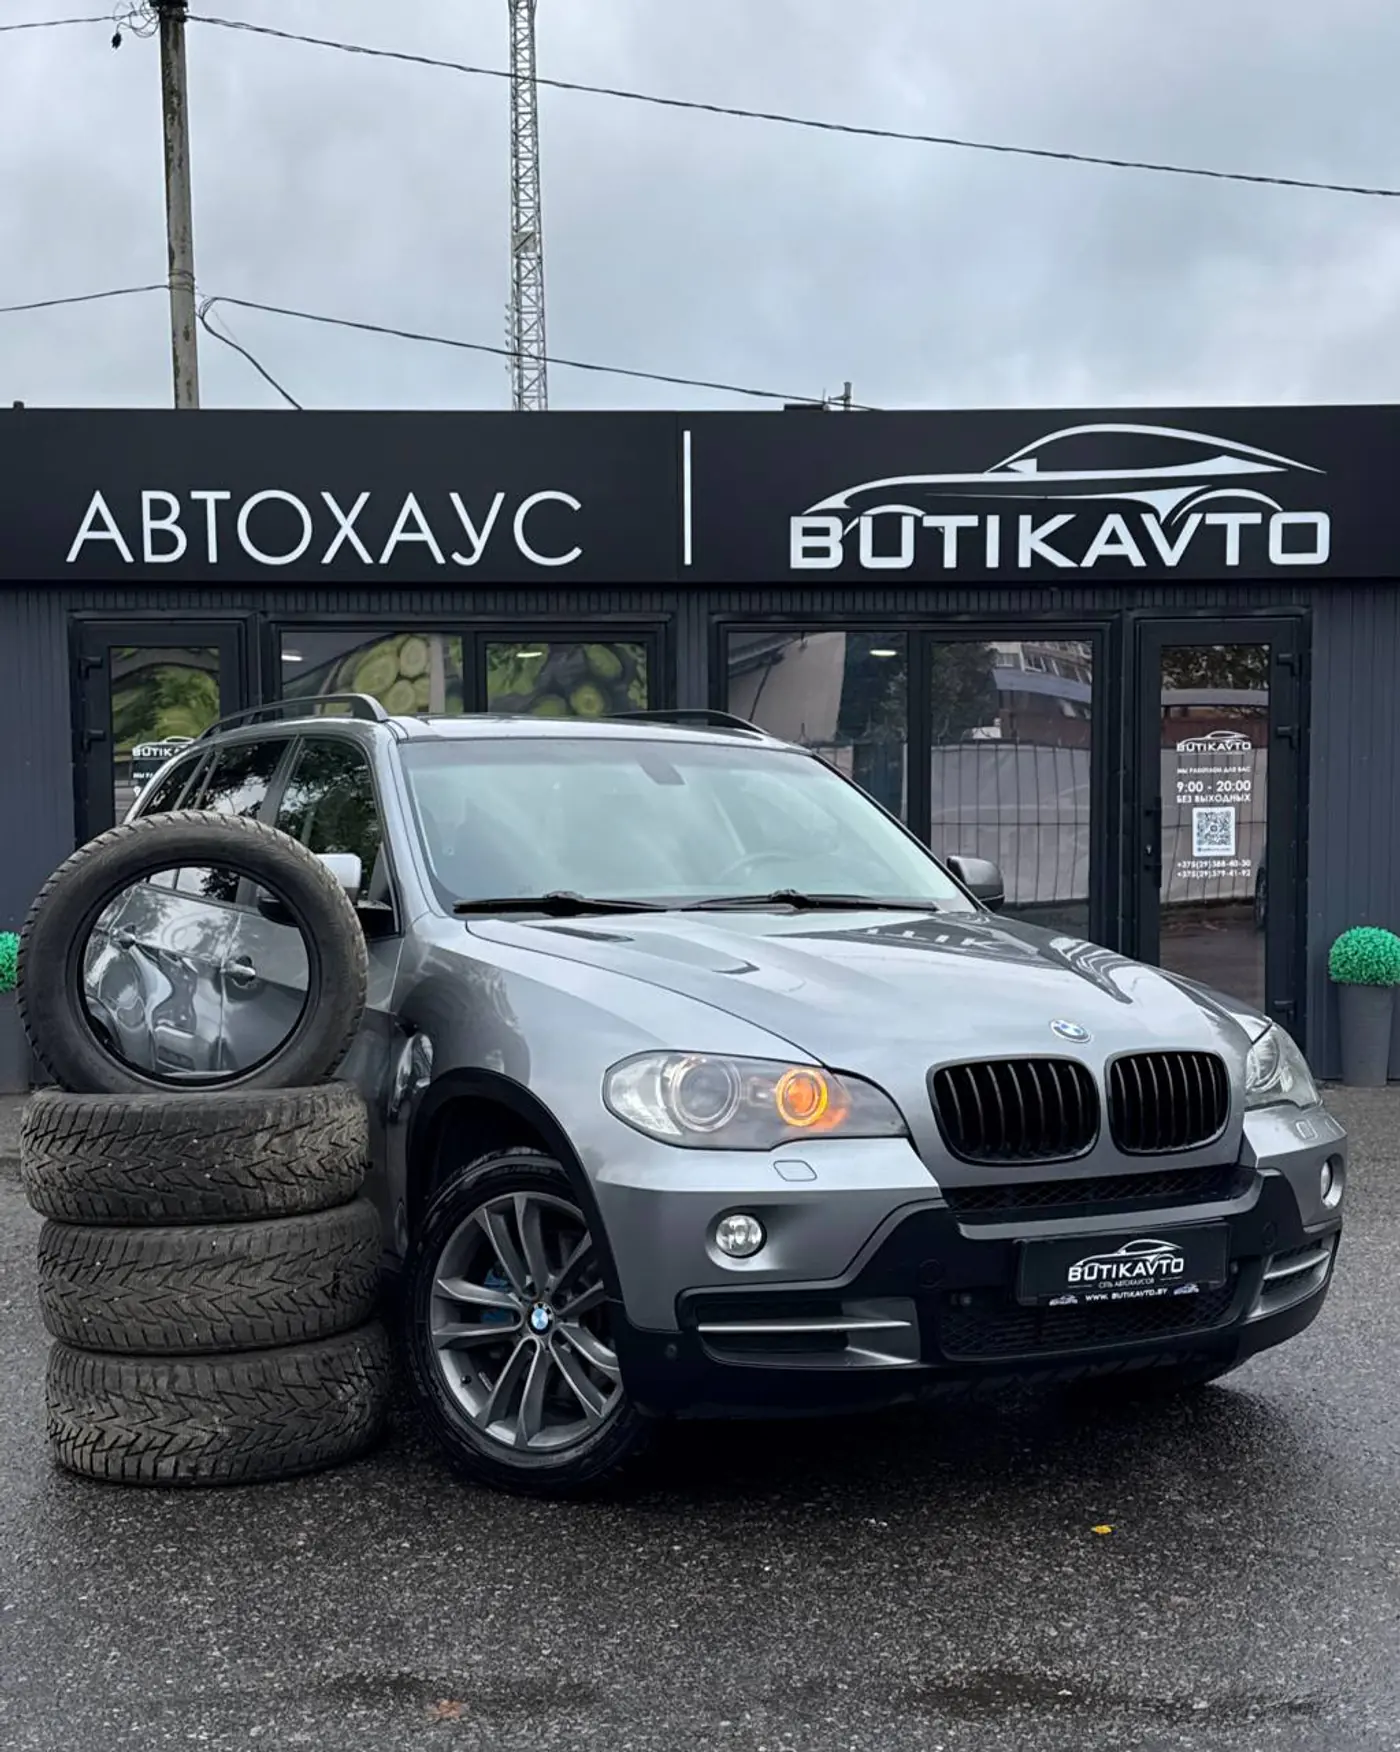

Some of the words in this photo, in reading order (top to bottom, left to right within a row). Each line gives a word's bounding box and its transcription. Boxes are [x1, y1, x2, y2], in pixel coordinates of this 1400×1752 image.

[66, 489, 583, 567] АВТОХАУС
[790, 511, 1331, 569] BUTIKAVTO
[1176, 741, 1252, 752] BUTIKAVTO
[1177, 781, 1203, 793] 9:00
[1216, 780, 1251, 792] 20:00
[1177, 795, 1192, 803] БЕЗ
[1194, 793, 1252, 803] ВЫХОДНЫХ
[1068, 1258, 1184, 1282] BUTIKAVTO
